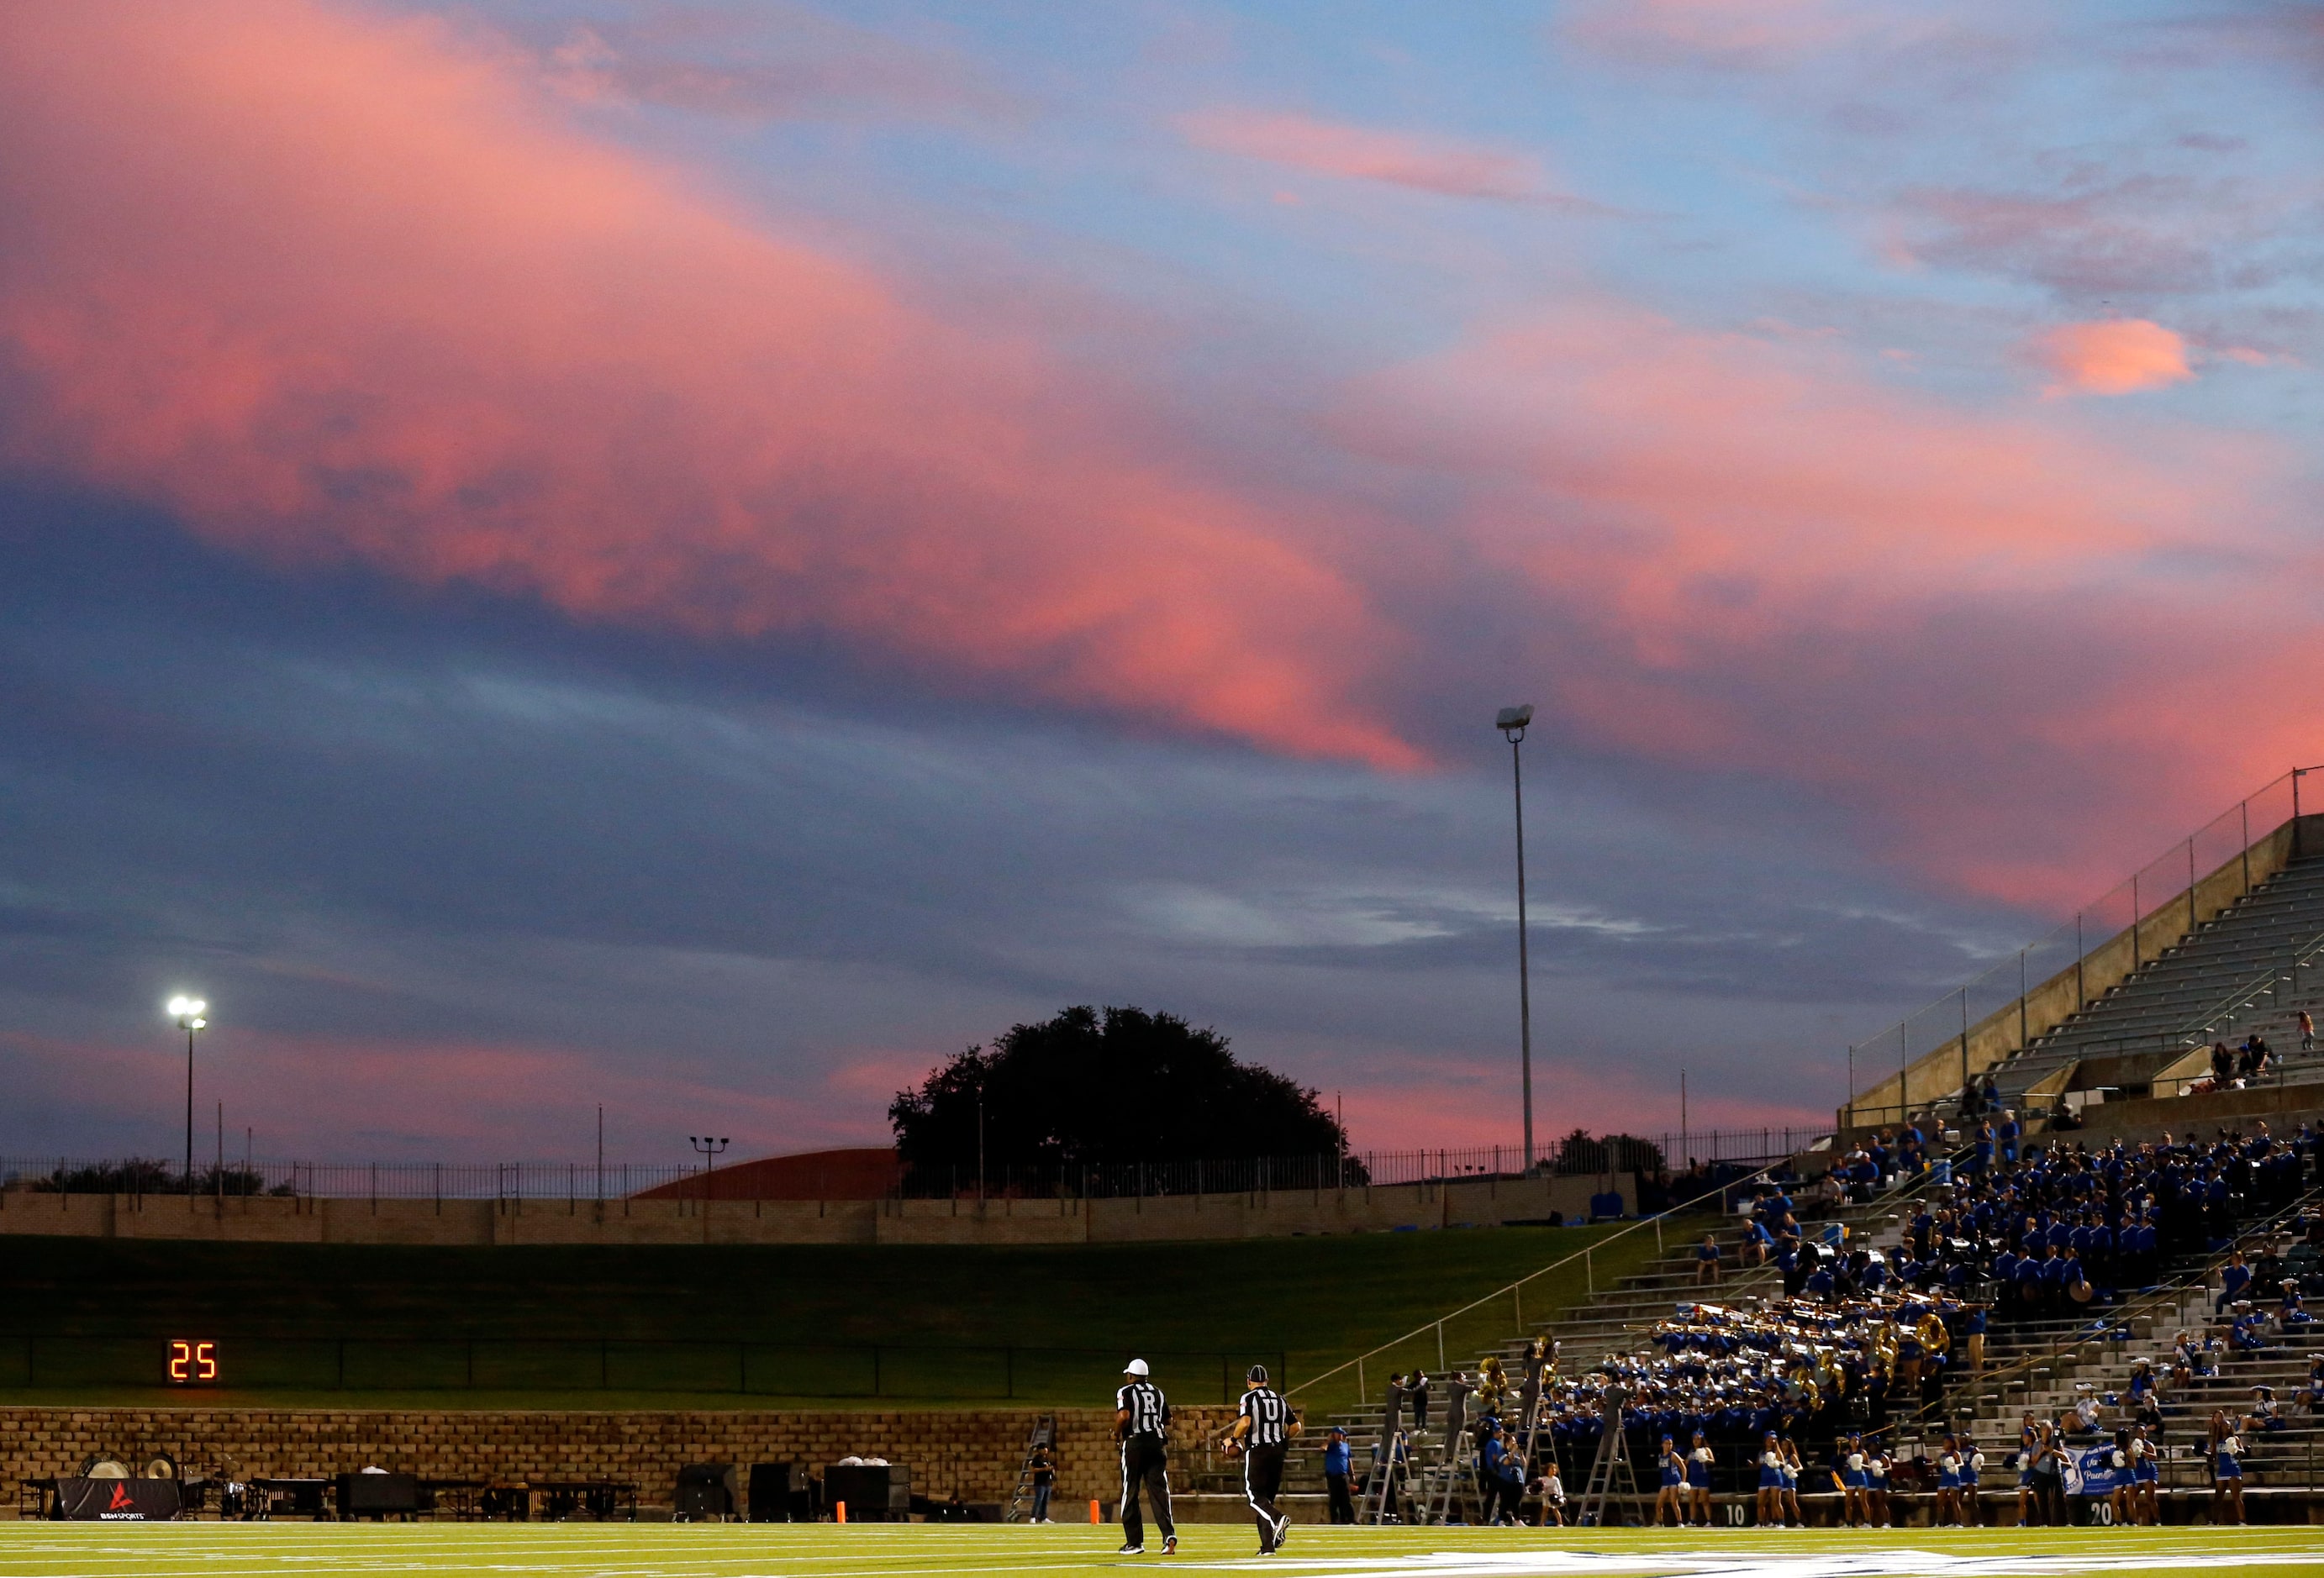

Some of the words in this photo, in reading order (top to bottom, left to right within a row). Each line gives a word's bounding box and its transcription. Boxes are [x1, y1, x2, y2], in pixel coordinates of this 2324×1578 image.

[171, 1343, 214, 1378] 25
[1141, 1391, 1157, 1413] R
[1262, 1398, 1278, 1421] U
[1726, 1504, 1744, 1525] 10
[2091, 1502, 2112, 1525] 20
